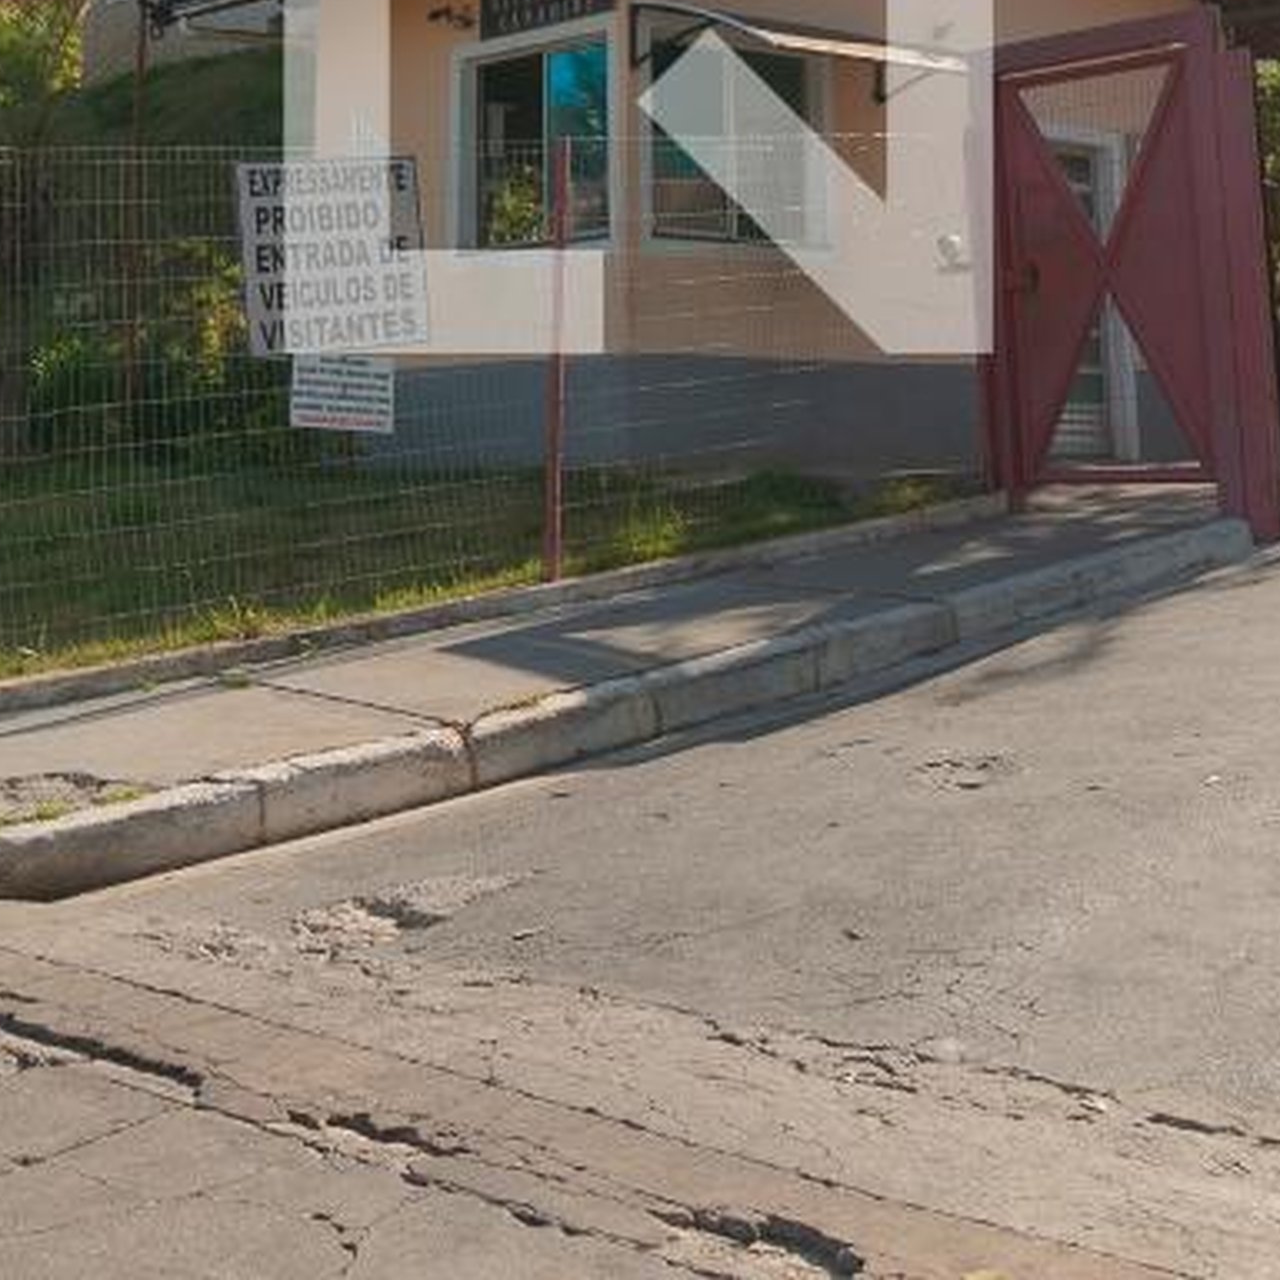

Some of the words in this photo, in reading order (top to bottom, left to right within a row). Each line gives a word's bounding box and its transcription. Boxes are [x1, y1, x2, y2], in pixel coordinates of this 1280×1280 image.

[255, 203, 379, 234] PROIBIDO
[255, 239, 371, 274] ENTRADA
[379, 235, 409, 263] DE
[383, 271, 414, 301] DE
[260, 308, 418, 350] VISITANTES
